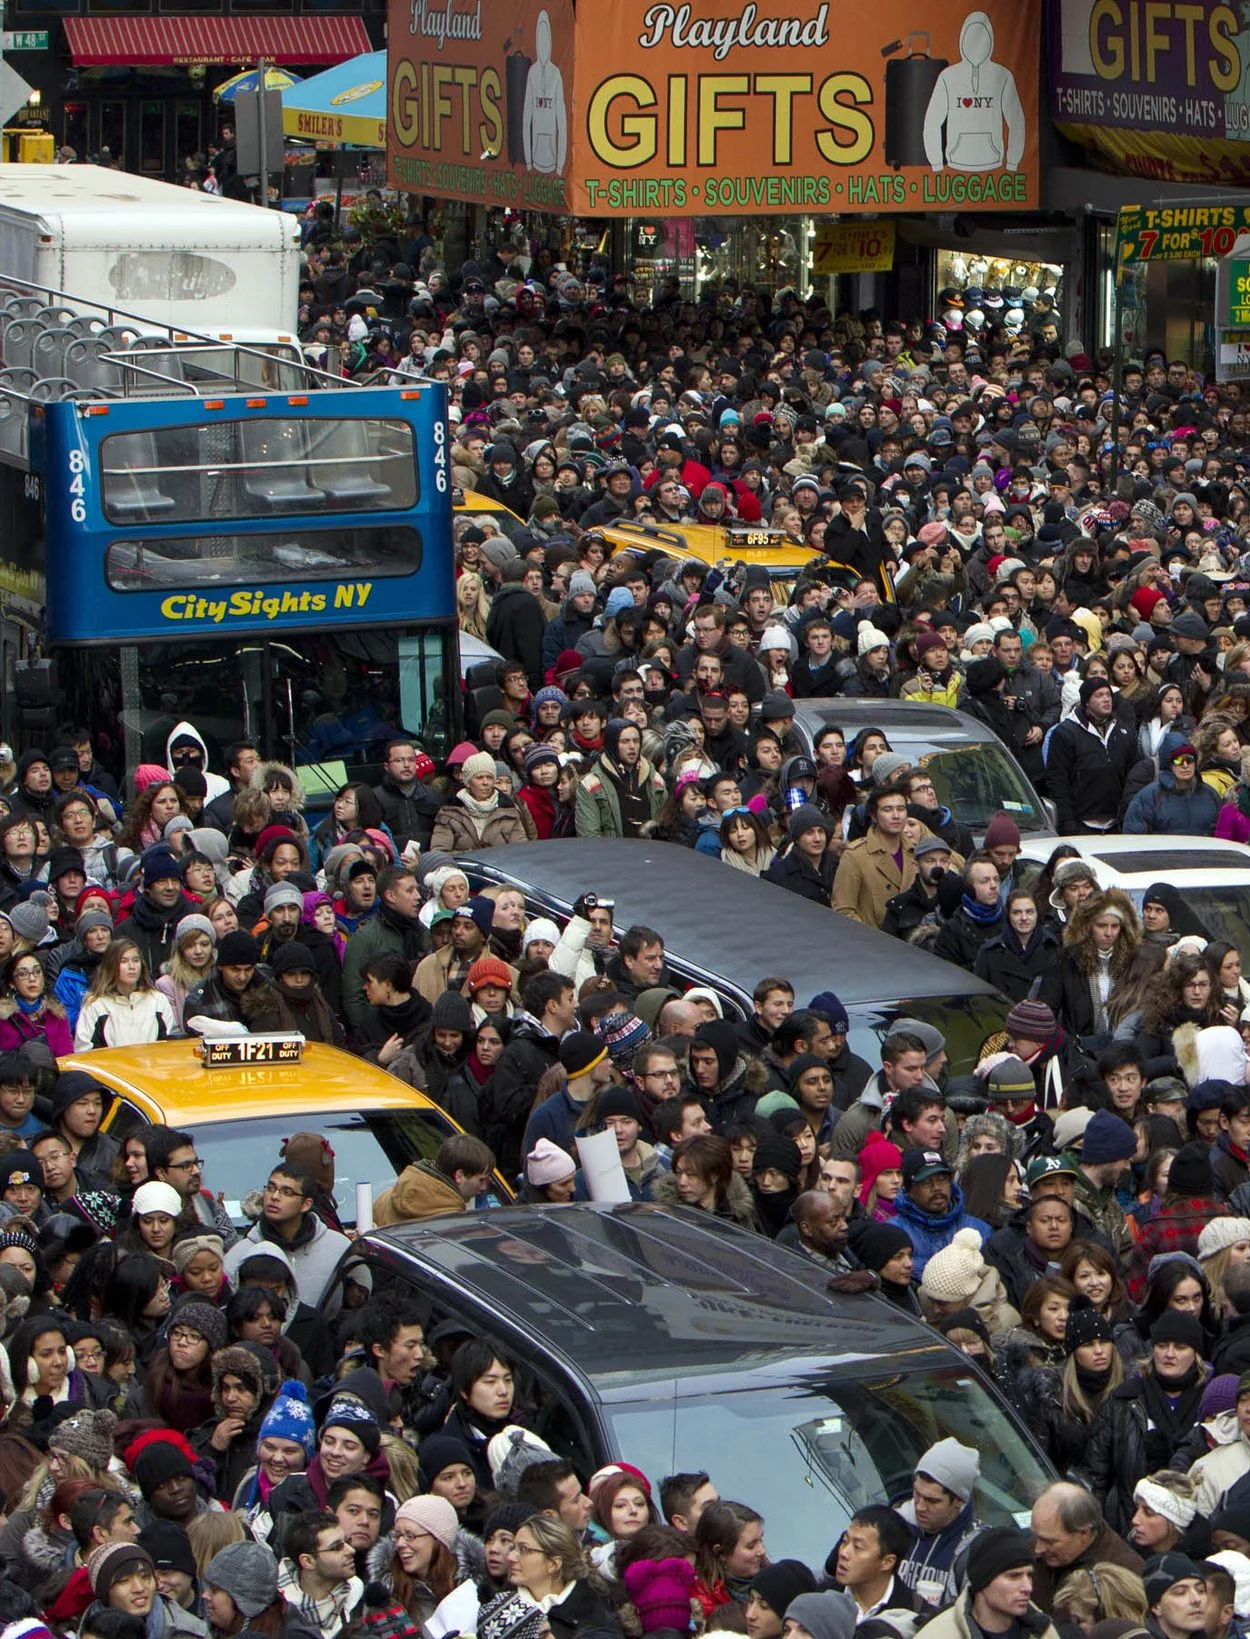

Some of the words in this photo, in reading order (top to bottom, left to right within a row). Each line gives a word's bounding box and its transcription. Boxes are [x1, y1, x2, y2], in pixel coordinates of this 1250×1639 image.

[15, 34, 23, 47] W
[25, 33, 36, 47] 48
[409, 0, 483, 50] Playland
[638, 2, 829, 61] Playland
[1089, 0, 1241, 93] GIFTS
[393, 57, 504, 159] GIFTS
[973, 97, 993, 108] NY
[1056, 87, 1104, 116] T-SHIRTS
[1112, 92, 1177, 124] SOUVENIRS
[1185, 100, 1216, 128] HATS
[298, 114, 343, 136] SMILER'S
[586, 71, 875, 169] GIFTS
[393, 155, 432, 187] T-SHIRTS
[437, 163, 487, 195] SOUVENIRS
[492, 172, 517, 200] HATS
[524, 176, 567, 206] LUGGAGE
[584, 178, 687, 208] T-SHIRTS
[704, 175, 830, 206] SOUVENIRS
[848, 174, 905, 204] HATS
[923, 173, 1027, 204] LUGGAGE
[1145, 207, 1236, 228] T-SHIRTS
[1138, 229, 1160, 260] 7
[1162, 233, 1190, 250] FOR
[434, 421, 447, 492] 846
[24, 474, 40, 500] 846
[68, 449, 86, 522] 846
[747, 532, 769, 544] 6F95
[334, 583, 373, 608] NY
[238, 1042, 273, 1060] 1F21
[279, 1050, 299, 1058] DUTY
